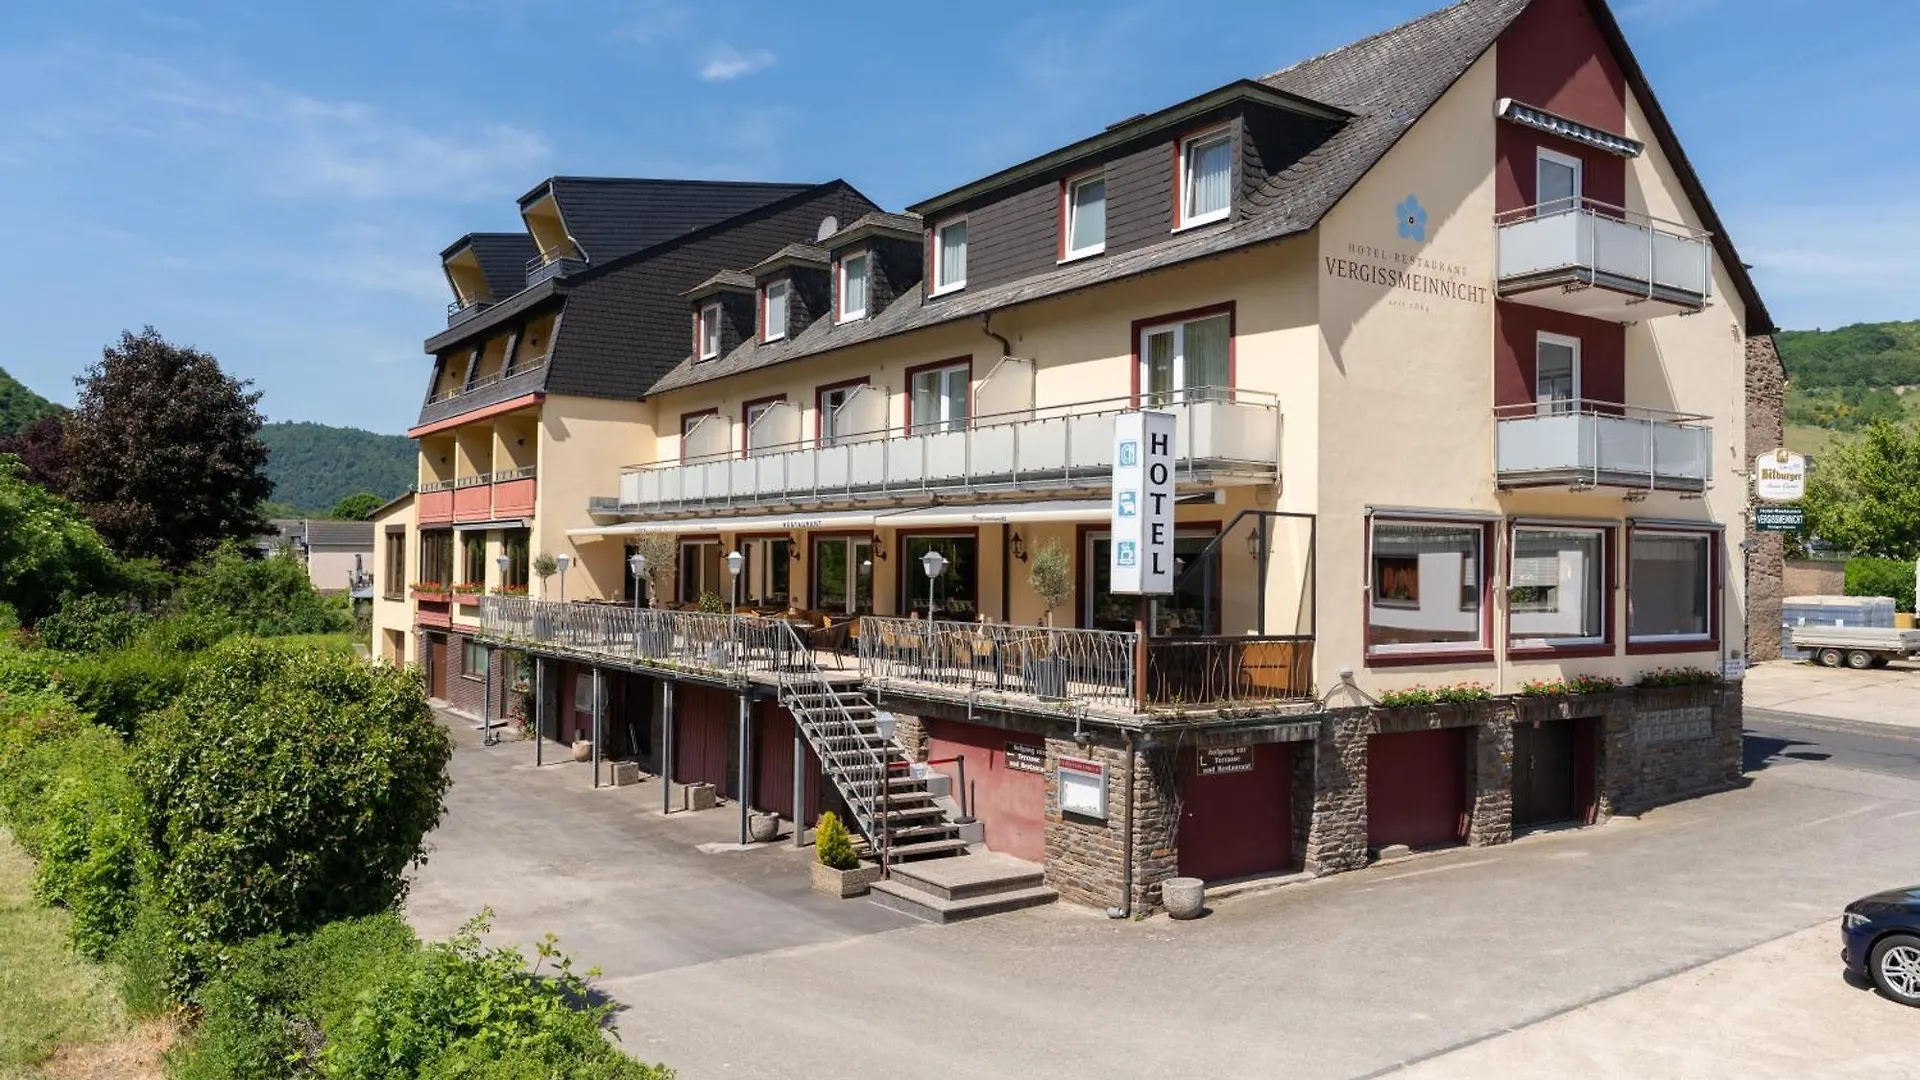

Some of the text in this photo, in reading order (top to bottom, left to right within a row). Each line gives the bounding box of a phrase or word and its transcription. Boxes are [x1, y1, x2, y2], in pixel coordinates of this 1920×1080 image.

[1325, 256, 1487, 304] VERGISSMEINNICHT
[1761, 468, 1802, 482] Bitburger
[1150, 432, 1168, 575] HOTEL
[782, 520, 822, 529] RESTAURANT
